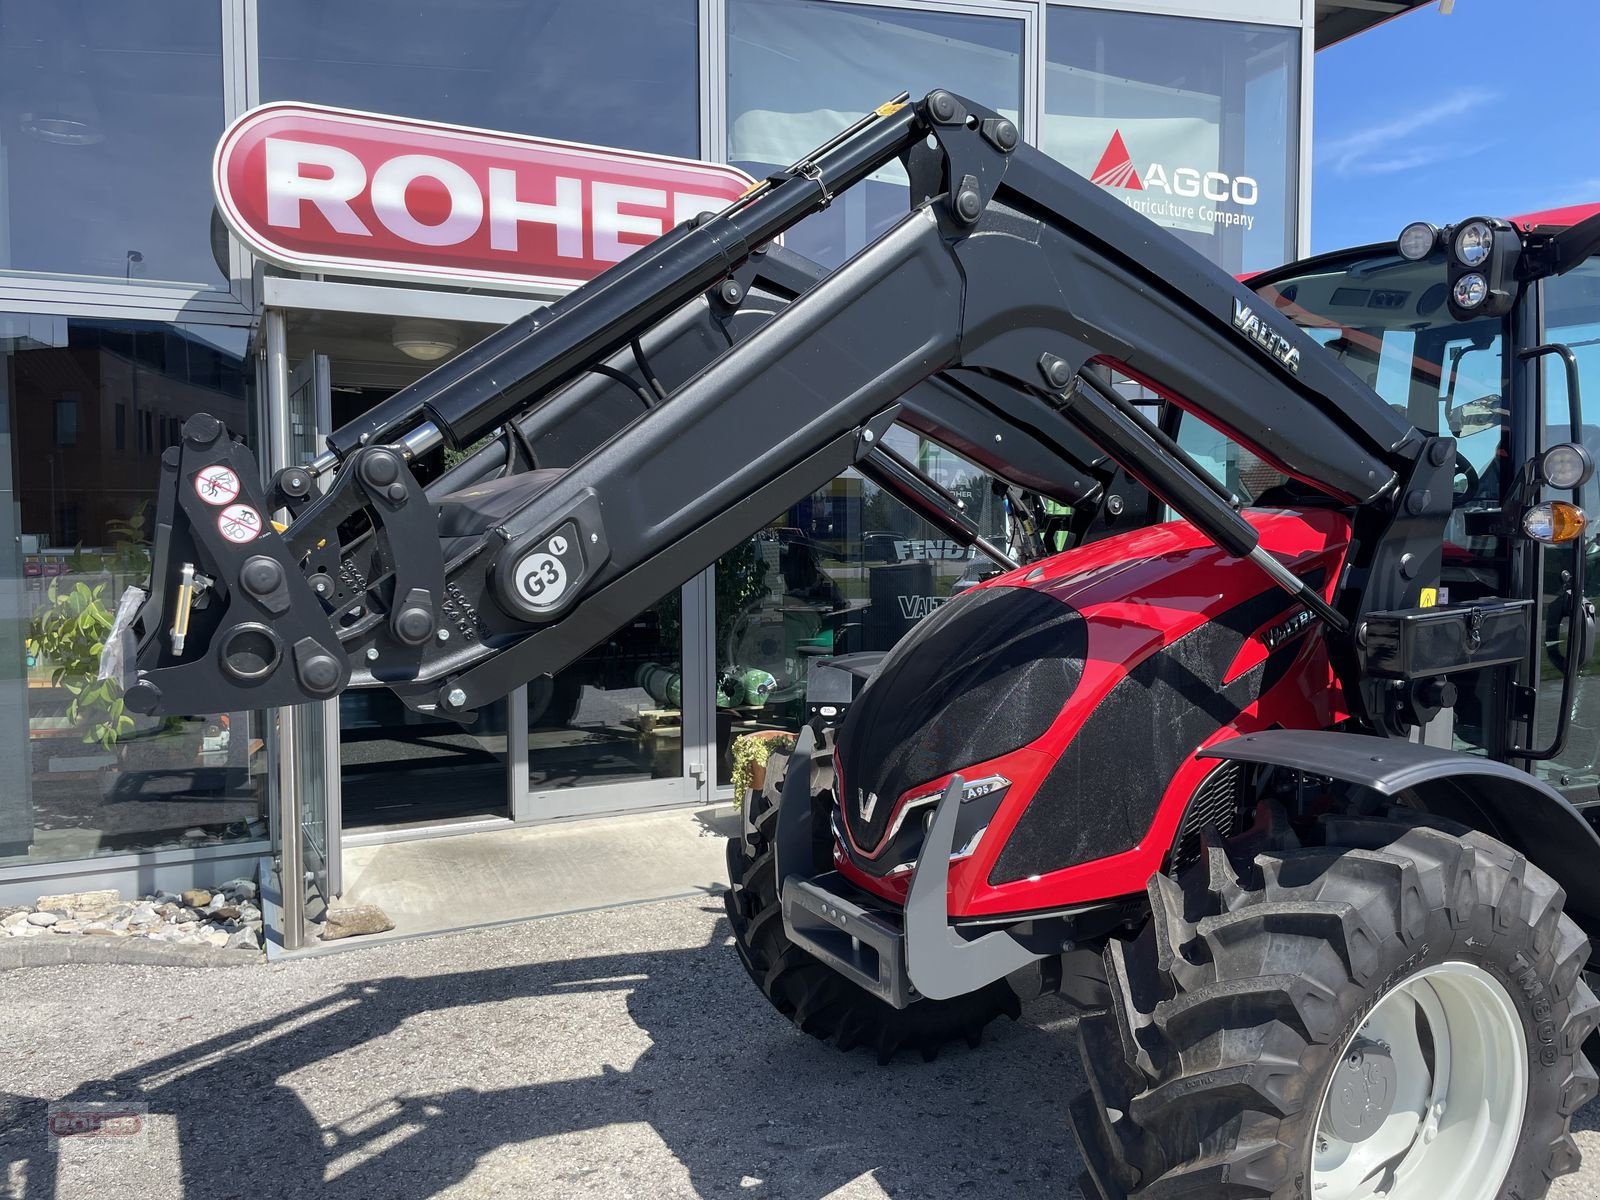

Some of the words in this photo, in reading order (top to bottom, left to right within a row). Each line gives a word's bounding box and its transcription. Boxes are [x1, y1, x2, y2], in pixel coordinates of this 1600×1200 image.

[1143, 163, 1258, 206] AGCO
[1199, 206, 1254, 231] Company
[1231, 297, 1300, 374] VALTRA
[523, 559, 560, 597] G3
[553, 540, 565, 553] L
